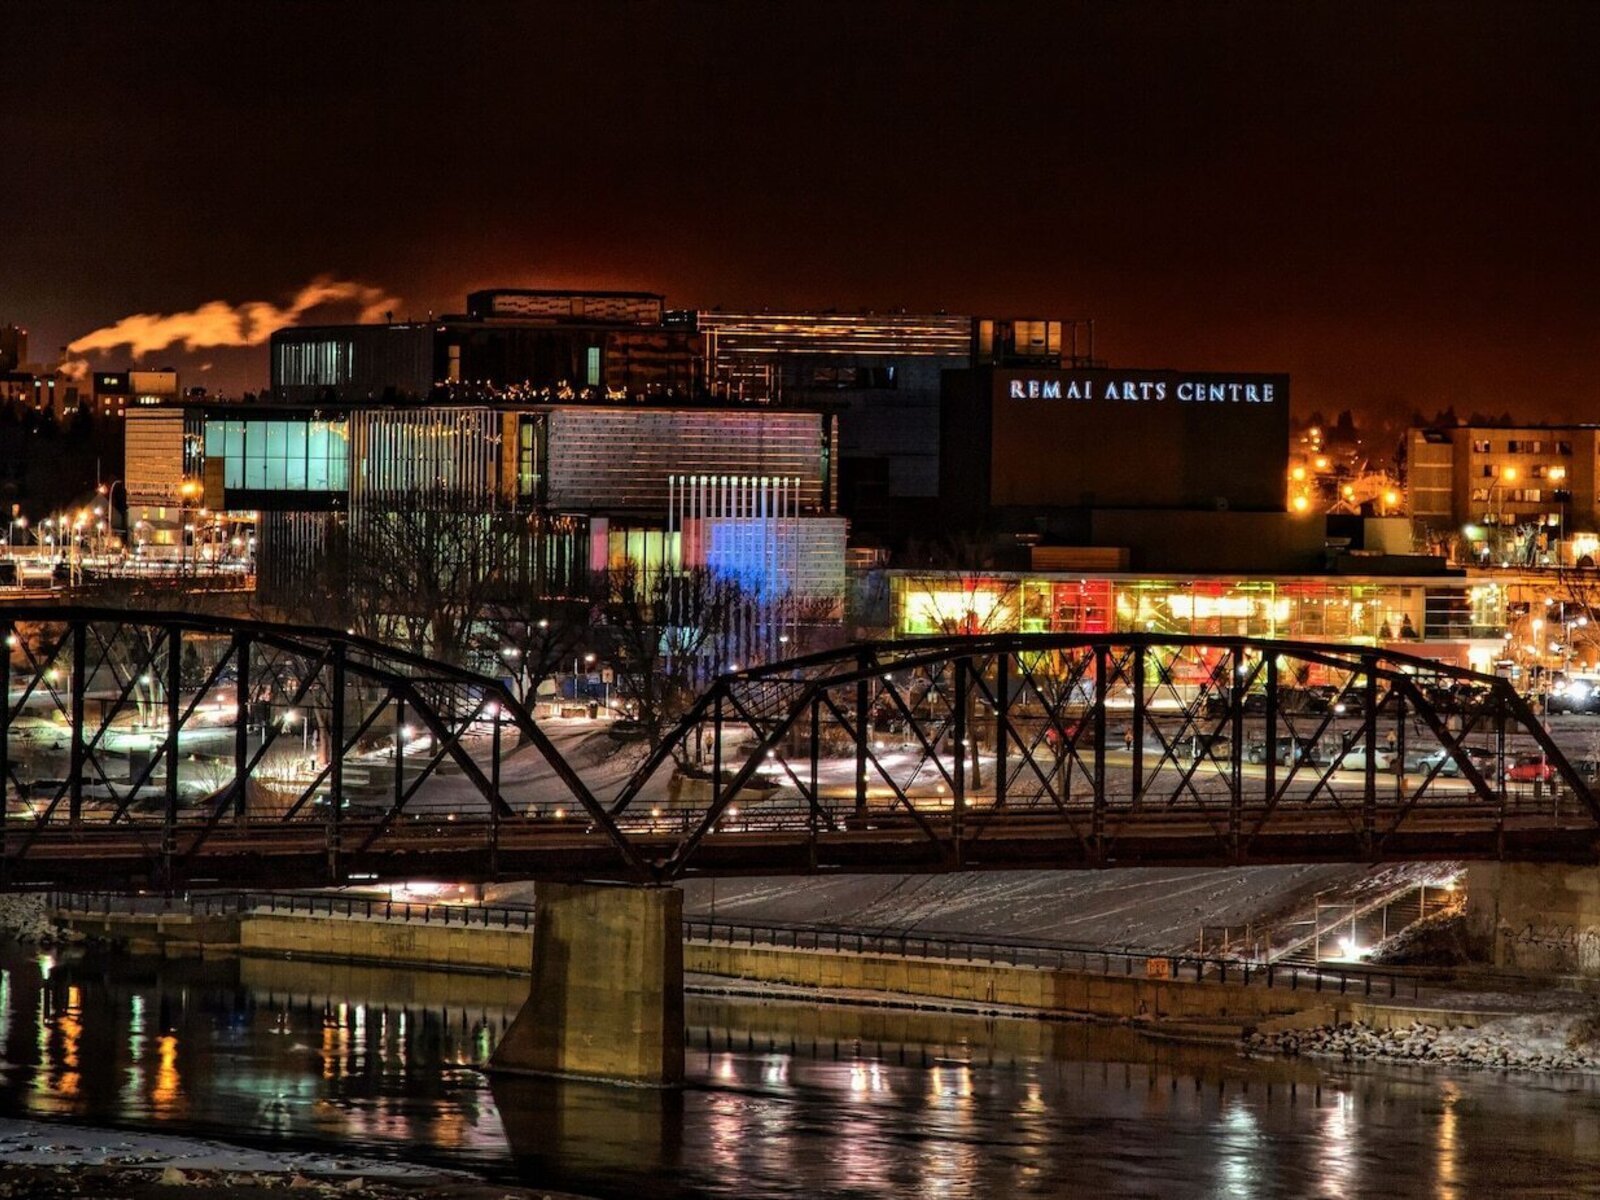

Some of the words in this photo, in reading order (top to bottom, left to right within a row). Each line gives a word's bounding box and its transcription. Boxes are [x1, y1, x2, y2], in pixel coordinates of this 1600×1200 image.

[1009, 379, 1092, 400] REMAI
[1104, 380, 1166, 401] ARTS
[1176, 382, 1275, 403] CENTRE
